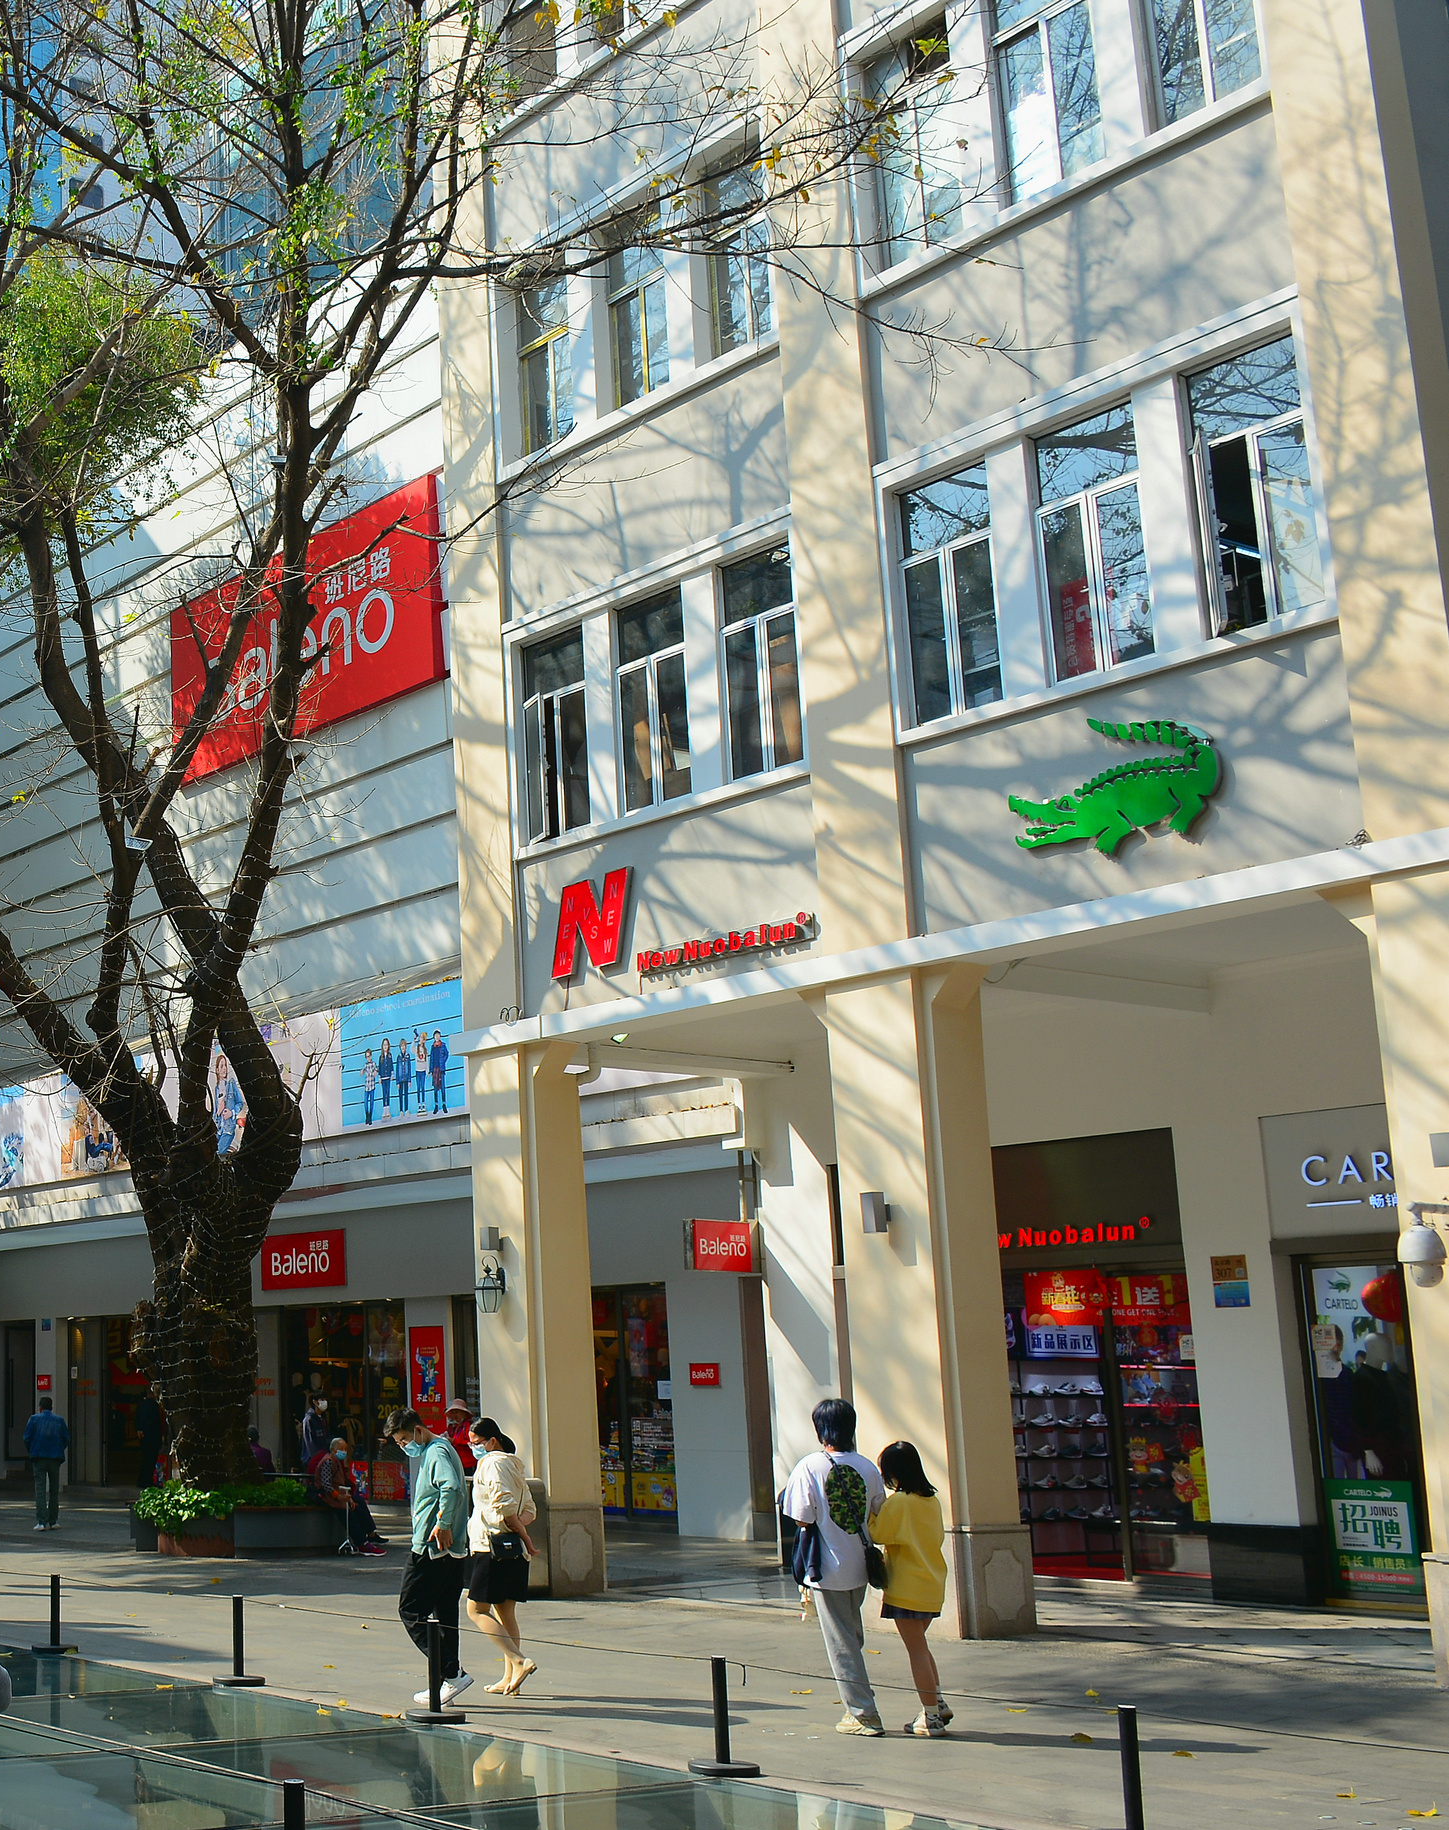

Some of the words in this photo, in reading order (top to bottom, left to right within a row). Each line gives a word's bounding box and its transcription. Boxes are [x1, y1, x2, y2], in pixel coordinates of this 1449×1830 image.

[324, 546, 392, 605] 班尼路
[637, 948, 679, 972] New
[377, 999, 401, 1014] school
[402, 990, 451, 1007] examination
[699, 1237, 747, 1257] Baleno
[272, 1248, 329, 1276] Baleno
[1325, 1297, 1359, 1310] CARTELO
[1031, 1333, 1093, 1351] 新品展示区
[692, 1370, 715, 1379] Baleno
[1343, 1488, 1372, 1496] CARTELO
[1338, 1502, 1403, 1549] 招聘
